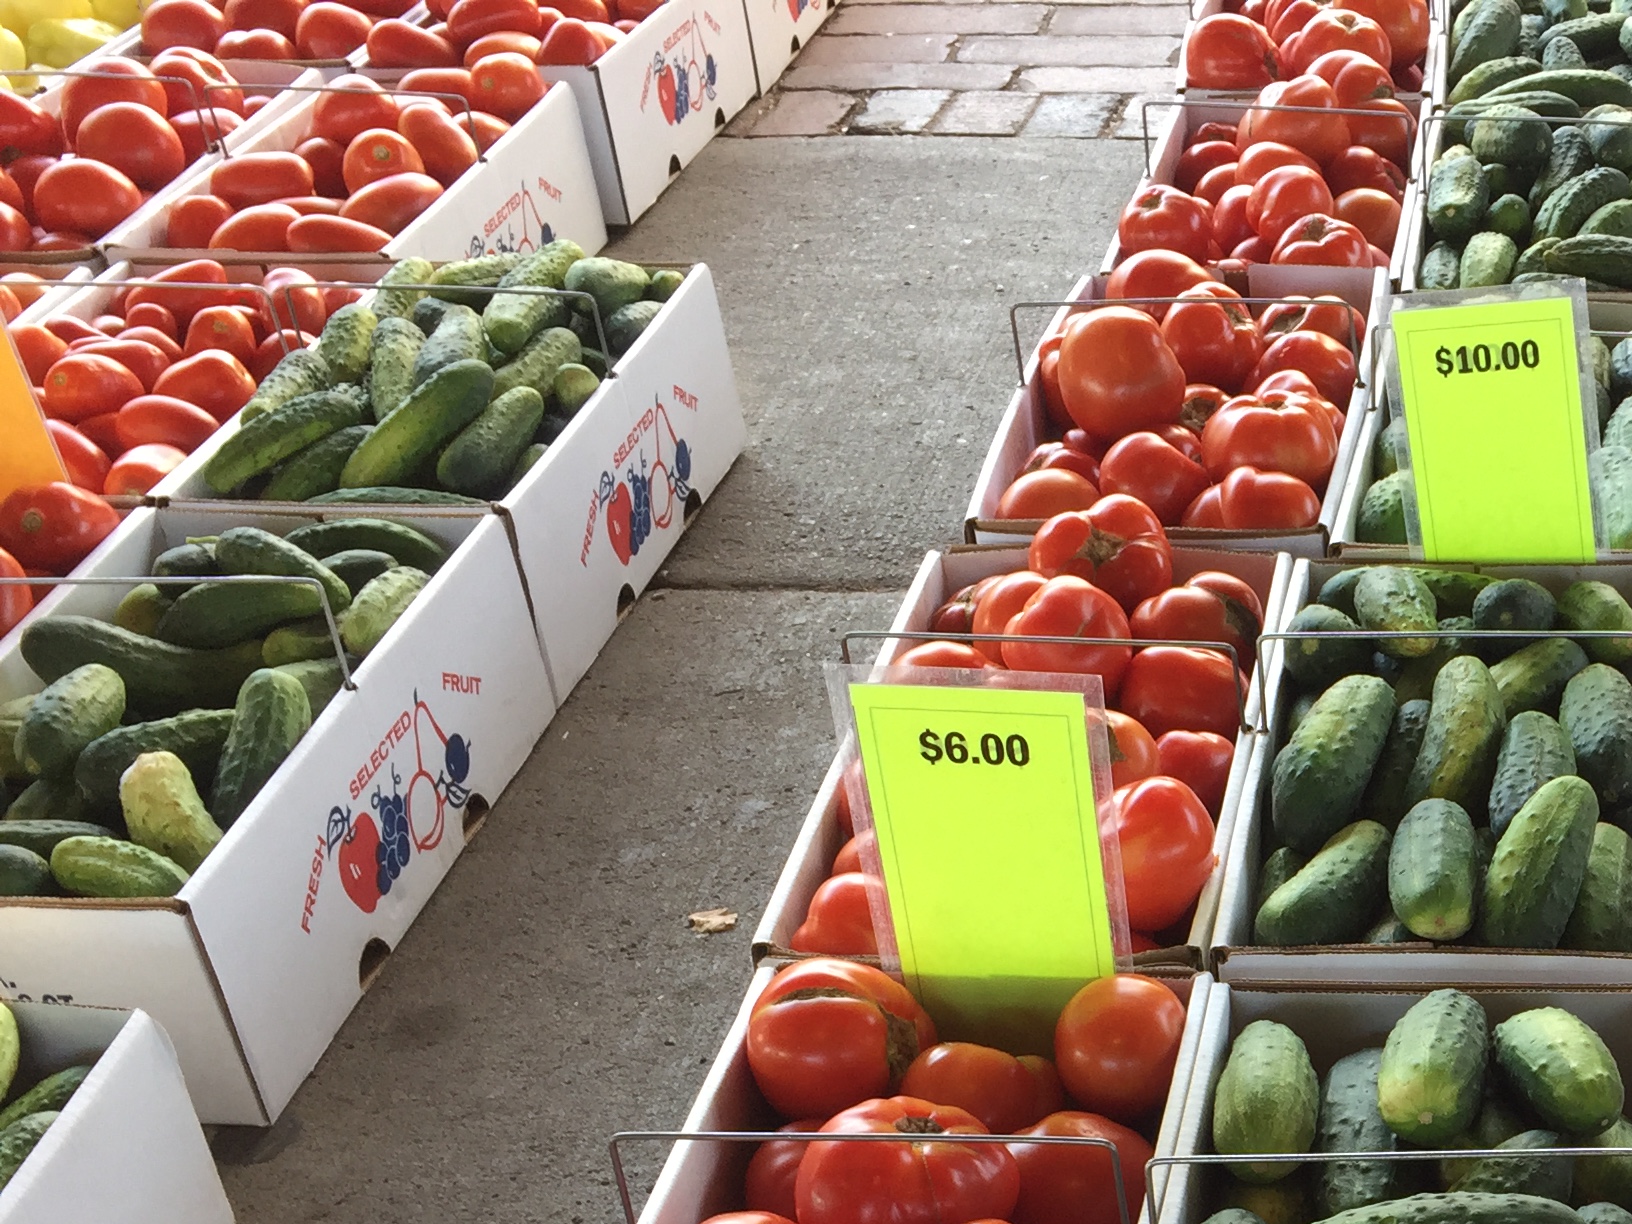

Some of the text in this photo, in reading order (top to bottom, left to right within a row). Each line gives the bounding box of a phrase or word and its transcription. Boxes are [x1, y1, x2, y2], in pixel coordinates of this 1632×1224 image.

[484, 176, 562, 237] SELECTED FRUIT
[1435, 339, 1540, 378] $10.00
[579, 384, 698, 568] FRESH SELECTED FRUIT
[918, 728, 1030, 767] $6.00
[301, 672, 482, 935] FRESH SELECTED FRUIT
